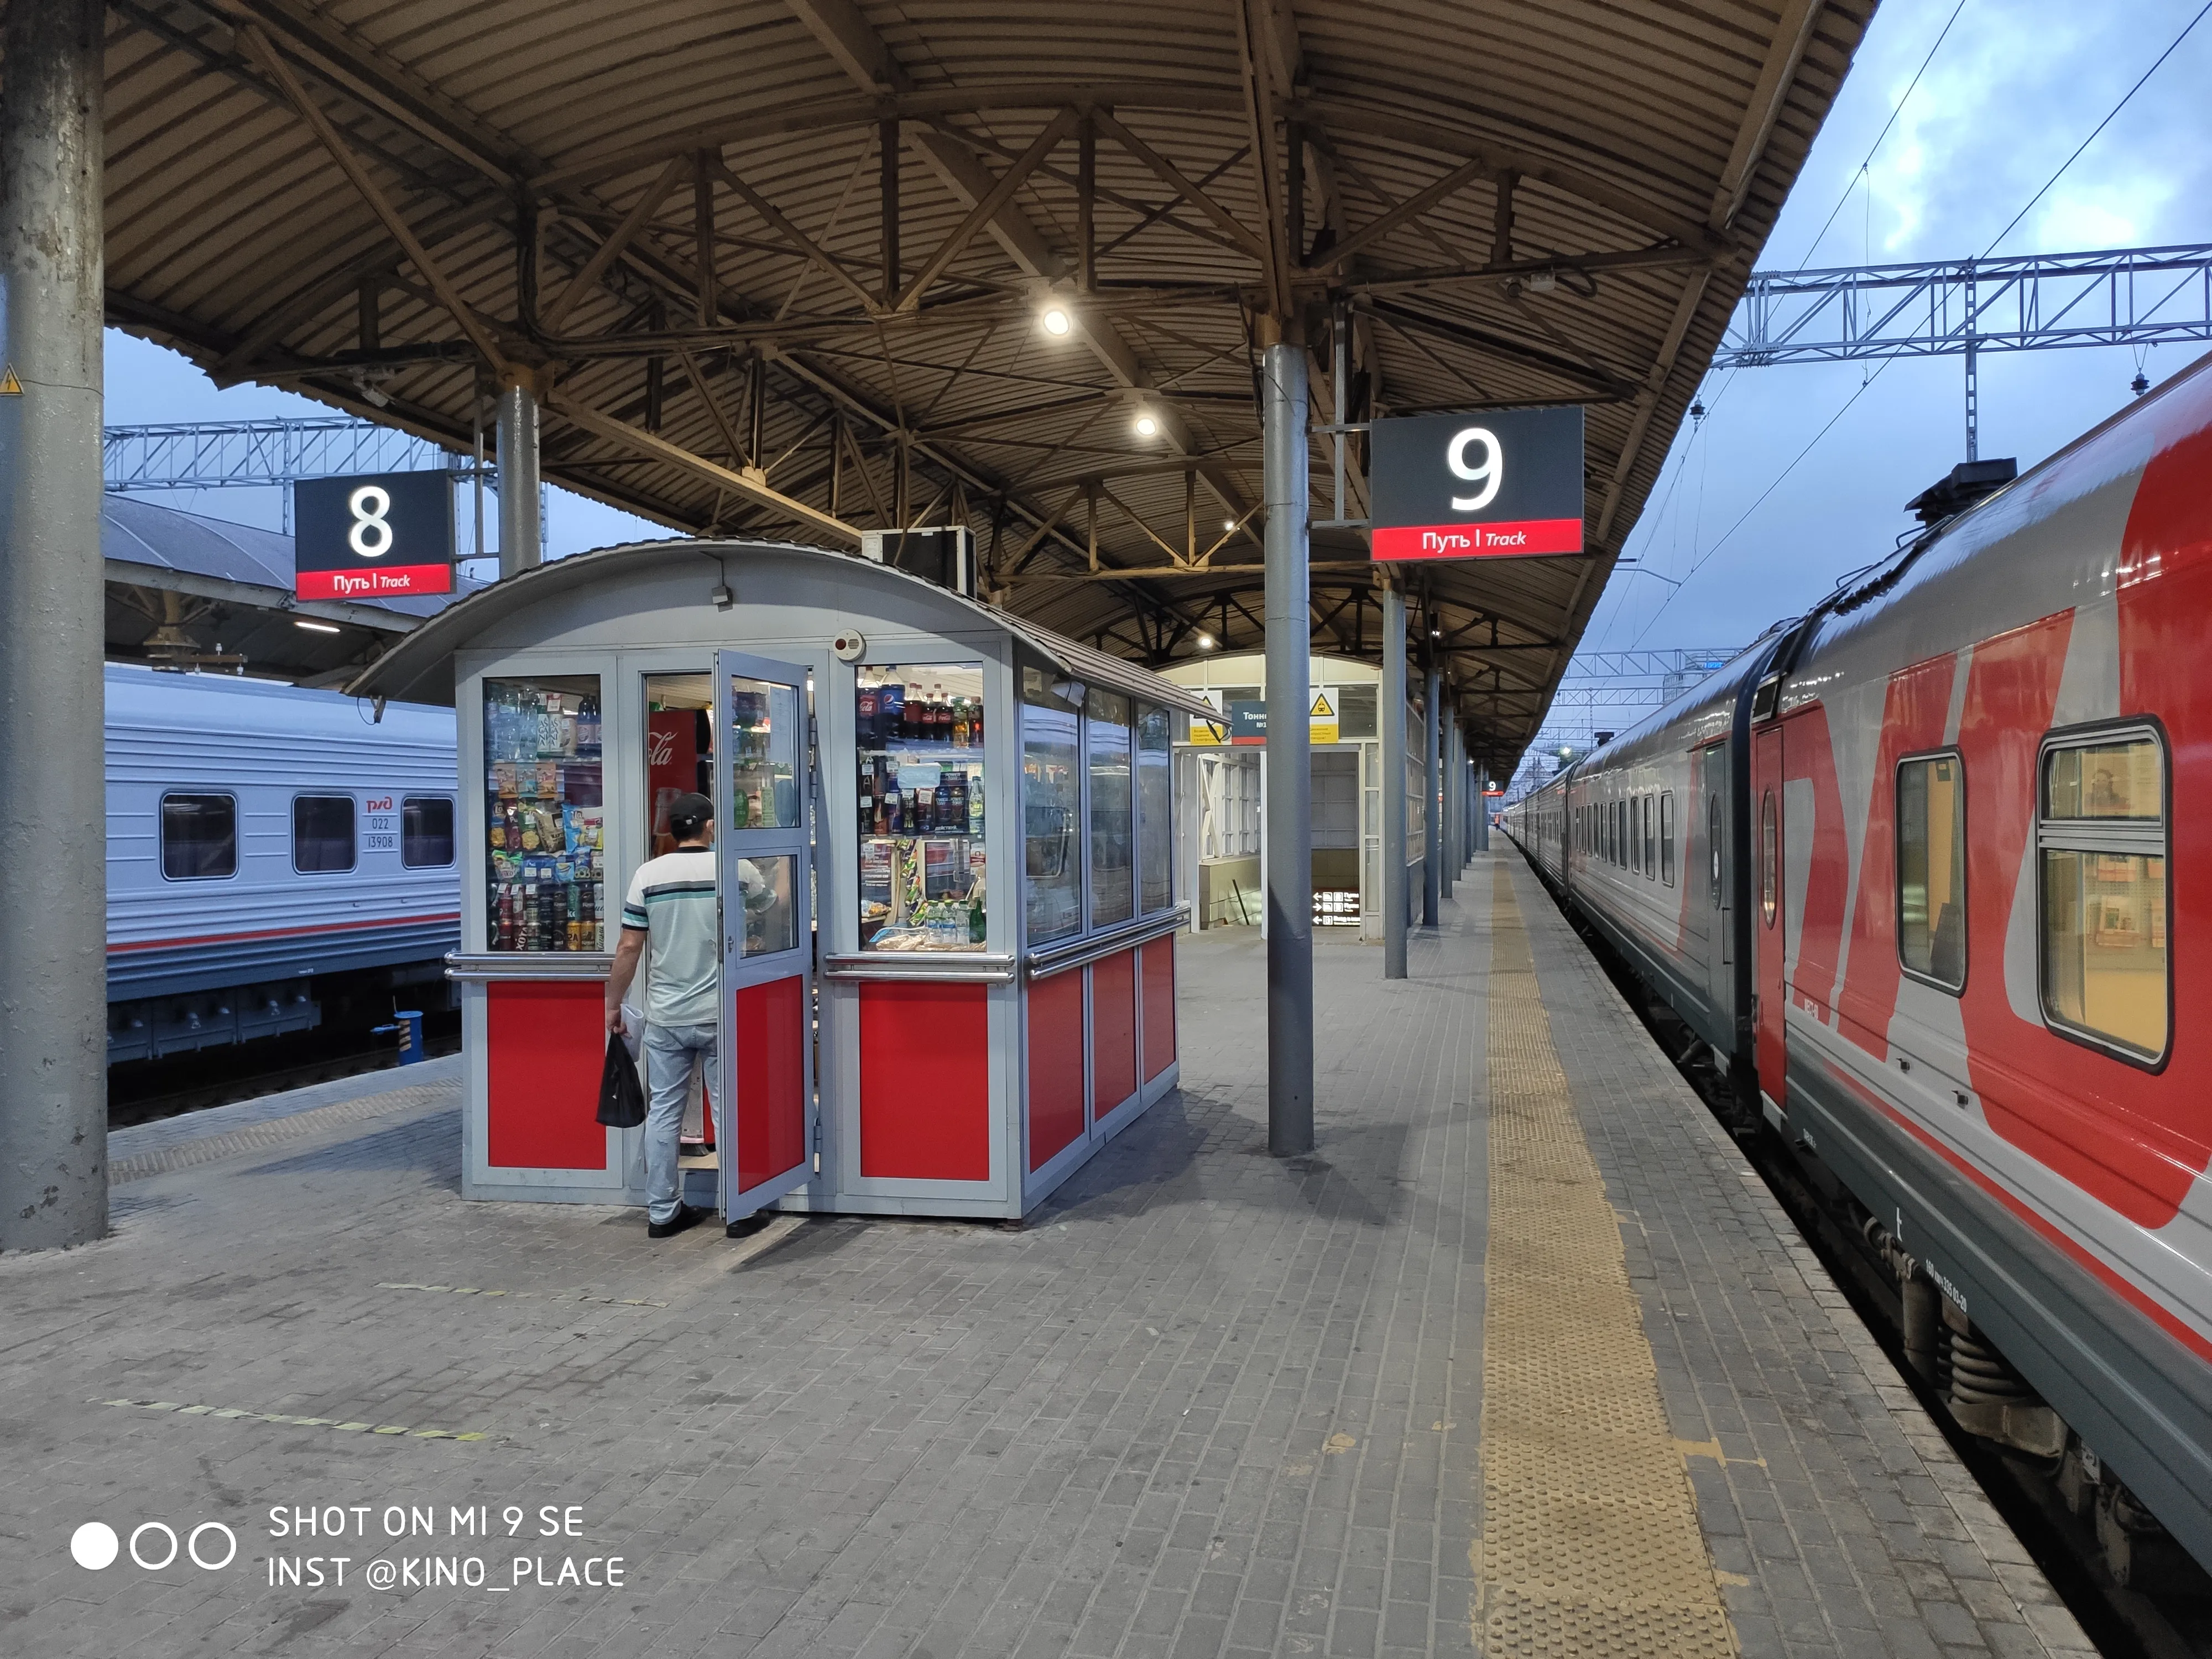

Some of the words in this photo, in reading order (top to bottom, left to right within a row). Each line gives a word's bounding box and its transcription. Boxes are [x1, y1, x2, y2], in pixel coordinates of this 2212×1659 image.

[1448, 428, 1503, 510] 9
[350, 486, 393, 557] 8
[1422, 533, 1471, 553] Путь
[1485, 531, 1527, 546] Track
[333, 575, 370, 593] Путь
[380, 574, 410, 588] Track
[1489, 781, 1496, 791] 9
[372, 818, 389, 830] 022
[368, 836, 393, 848] 13908
